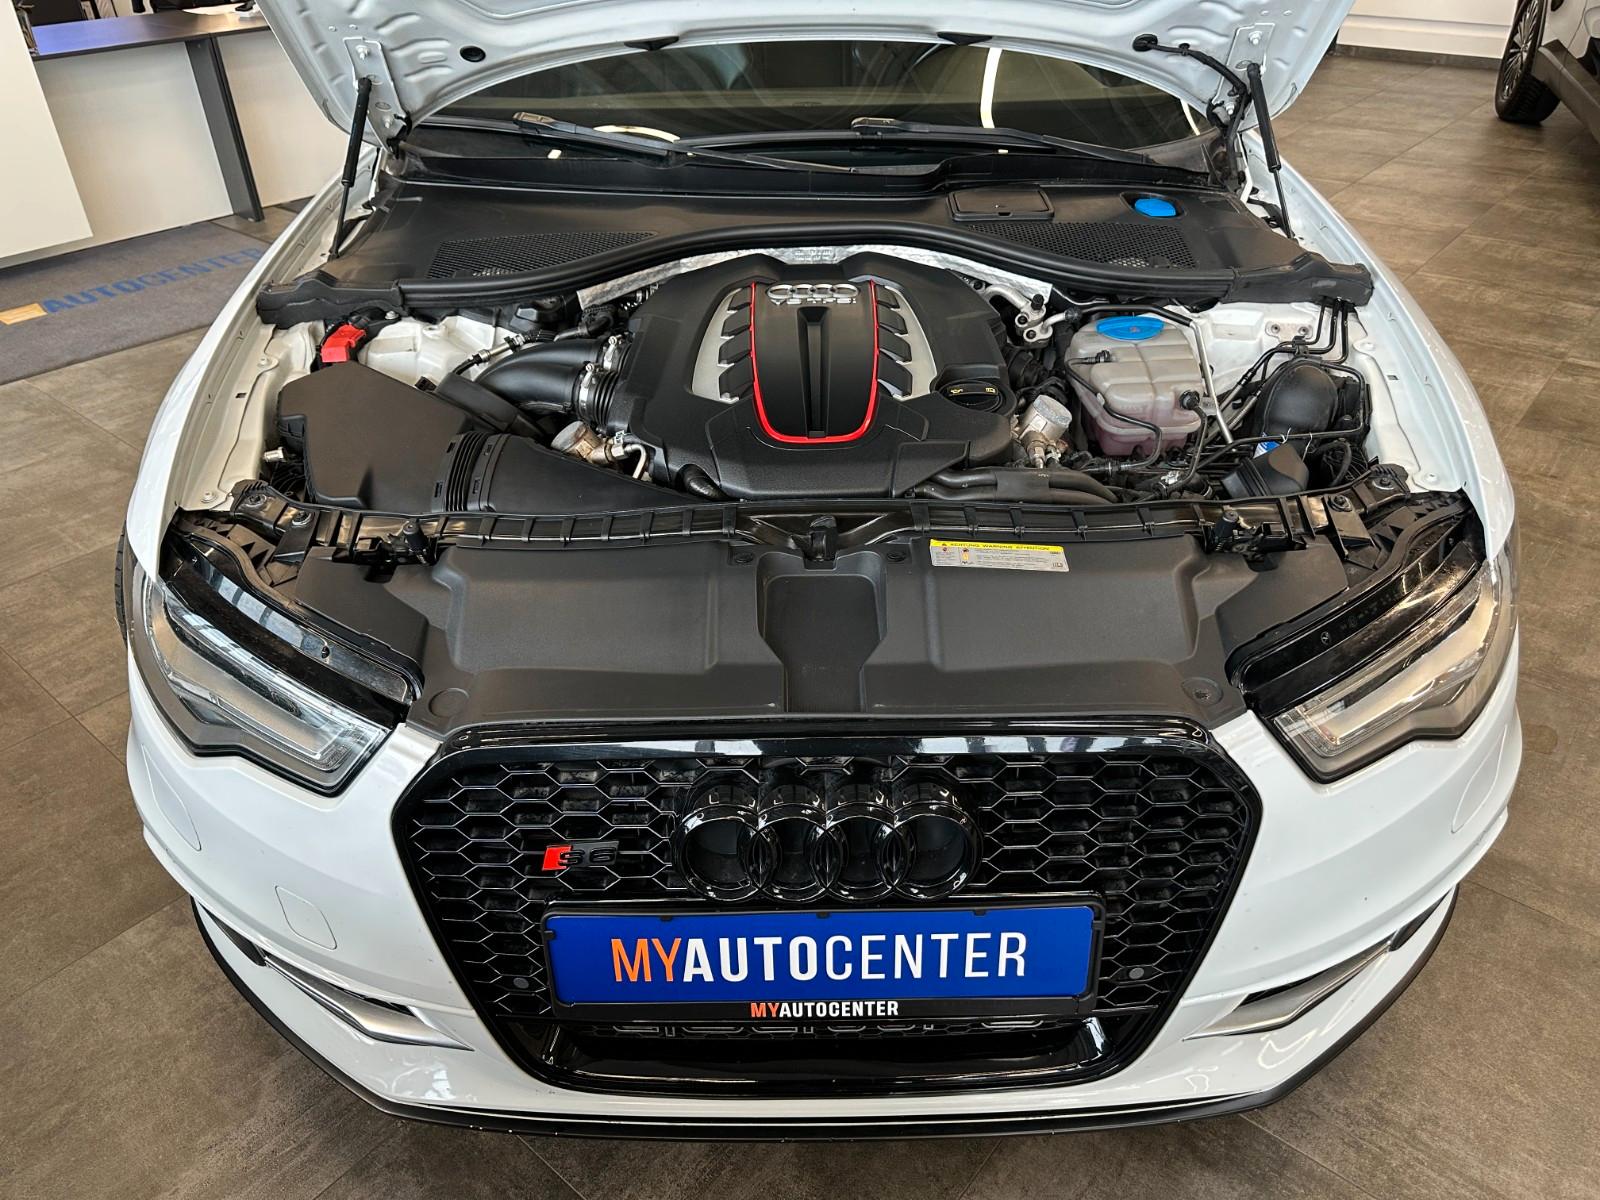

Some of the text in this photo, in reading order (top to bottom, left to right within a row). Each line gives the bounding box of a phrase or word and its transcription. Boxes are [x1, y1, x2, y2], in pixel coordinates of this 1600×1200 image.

[557, 846, 618, 867] S6
[611, 932, 1027, 982] MYAUTOCENTER
[750, 1000, 899, 1018] MYAUTOCENTER
